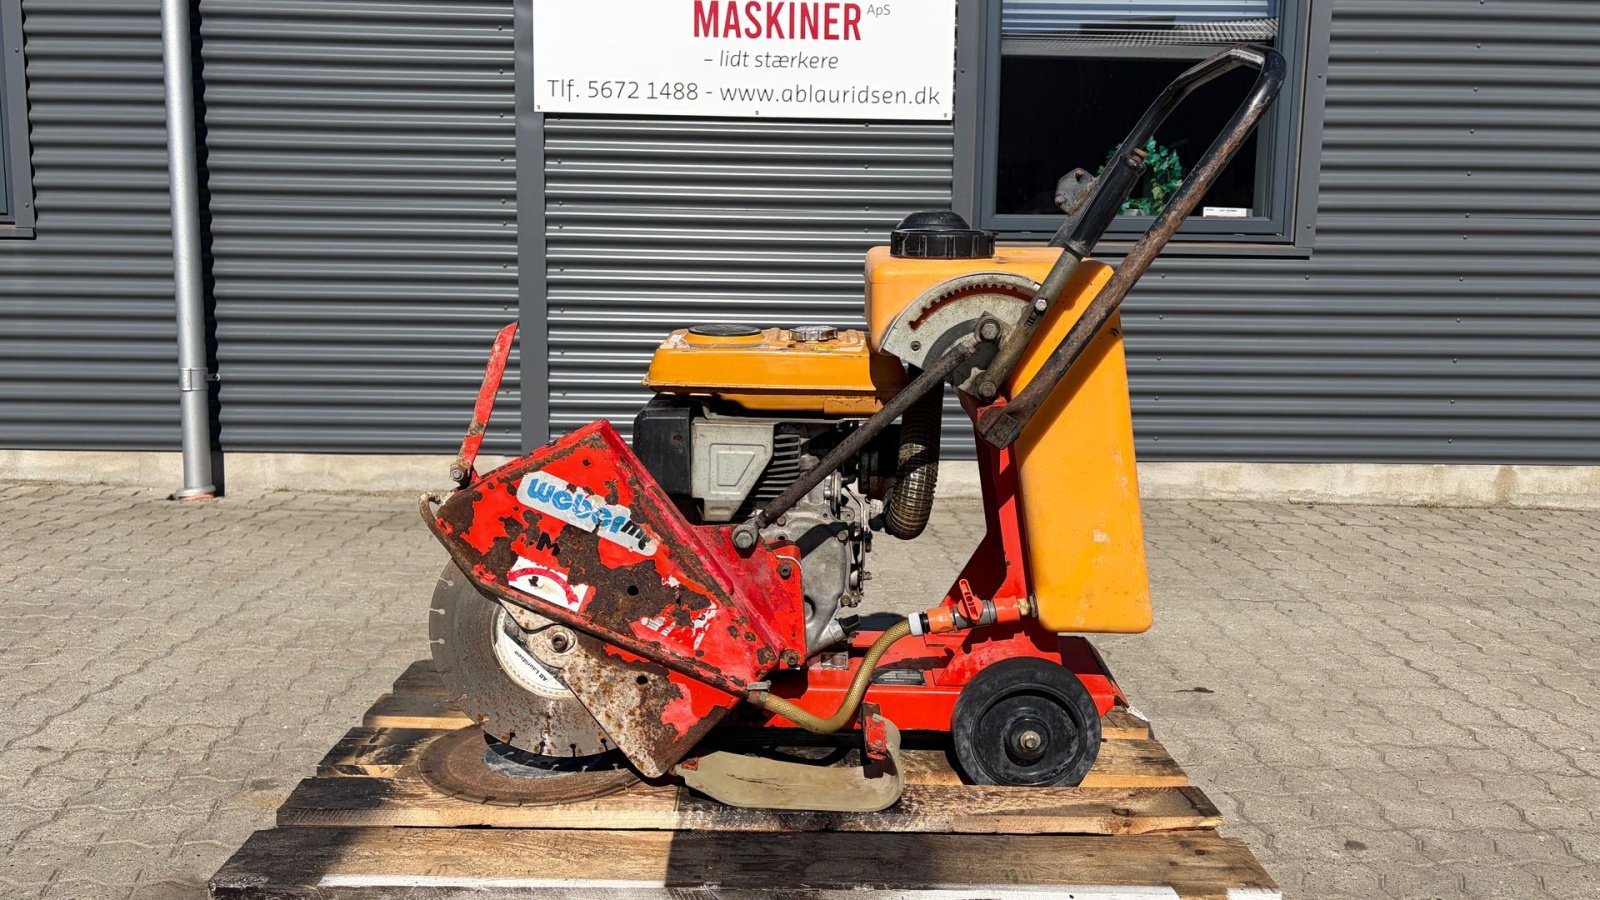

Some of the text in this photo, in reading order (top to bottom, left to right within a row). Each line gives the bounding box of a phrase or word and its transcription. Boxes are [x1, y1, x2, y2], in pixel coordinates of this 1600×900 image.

[694, 0, 862, 41] MASKINER
[866, 3, 891, 17] ApS
[719, 49, 750, 68] lidt
[753, 51, 839, 69] stærkere
[547, 79, 580, 102] Tlf.
[587, 80, 640, 99] 5672
[646, 81, 699, 101] 1488
[719, 84, 940, 105] www.ablauridsen.dk
[526, 478, 626, 534] weber
[538, 672, 548, 682] AB
